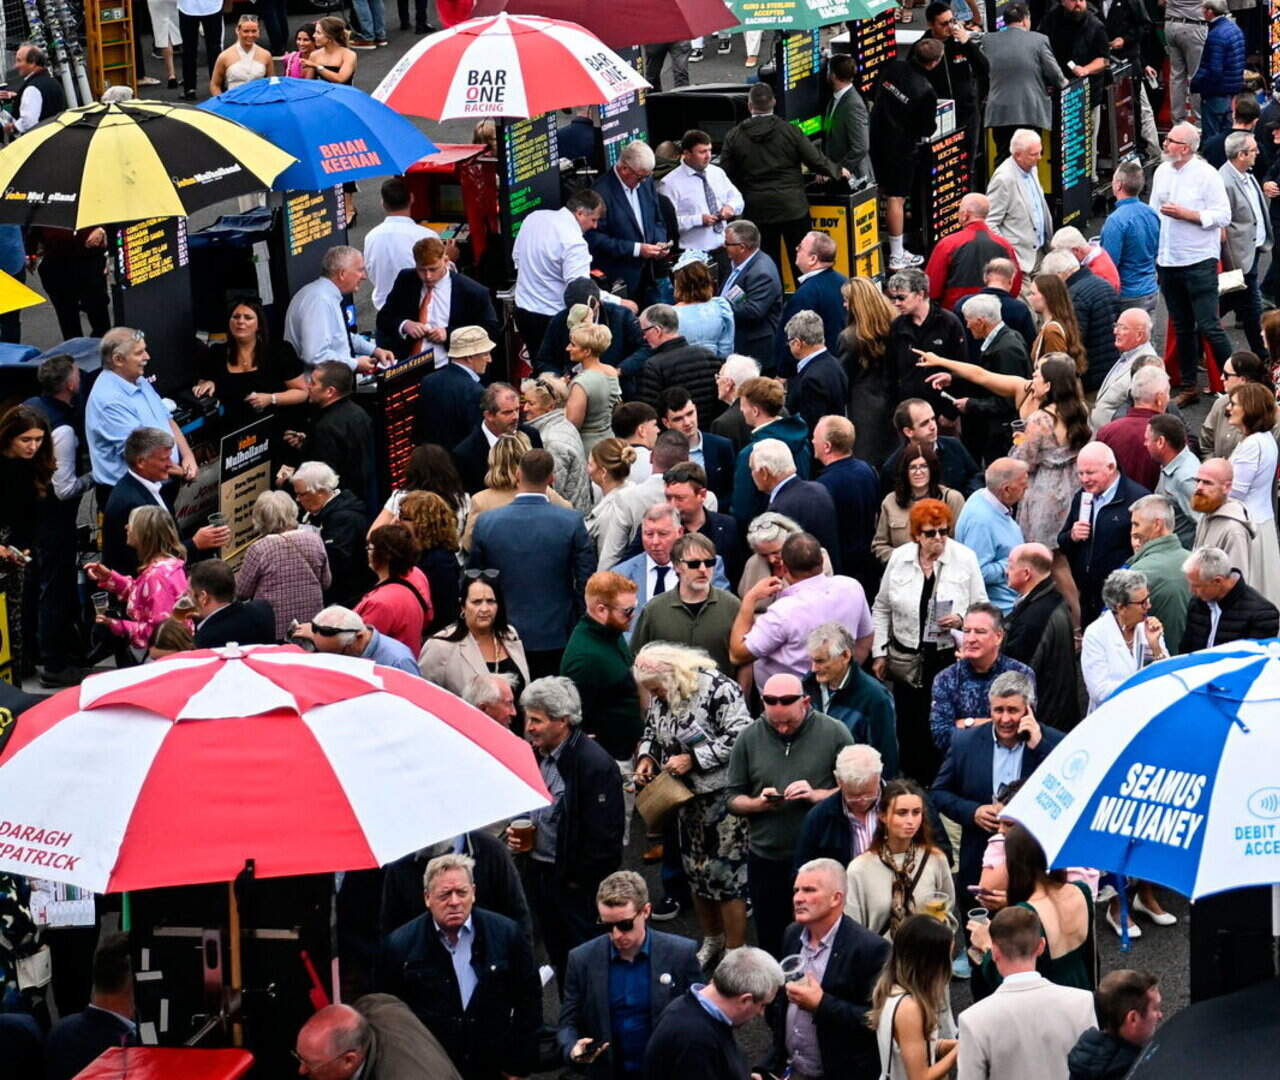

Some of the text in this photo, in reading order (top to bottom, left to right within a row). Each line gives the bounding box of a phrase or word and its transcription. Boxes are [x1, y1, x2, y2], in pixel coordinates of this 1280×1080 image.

[467, 69, 507, 86] BAR
[465, 86, 505, 103] ONE
[464, 103, 504, 113] RACING
[319, 138, 369, 160] BRIAN
[320, 151, 383, 174] KEENAN
[225, 438, 269, 471] Mulholland
[1120, 762, 1207, 810] SEAMUS
[1089, 795, 1204, 850] MULVANEY
[1234, 825, 1277, 841] DEBIT
[0, 821, 72, 848] DARAGH
[0, 841, 82, 871] PATRICK
